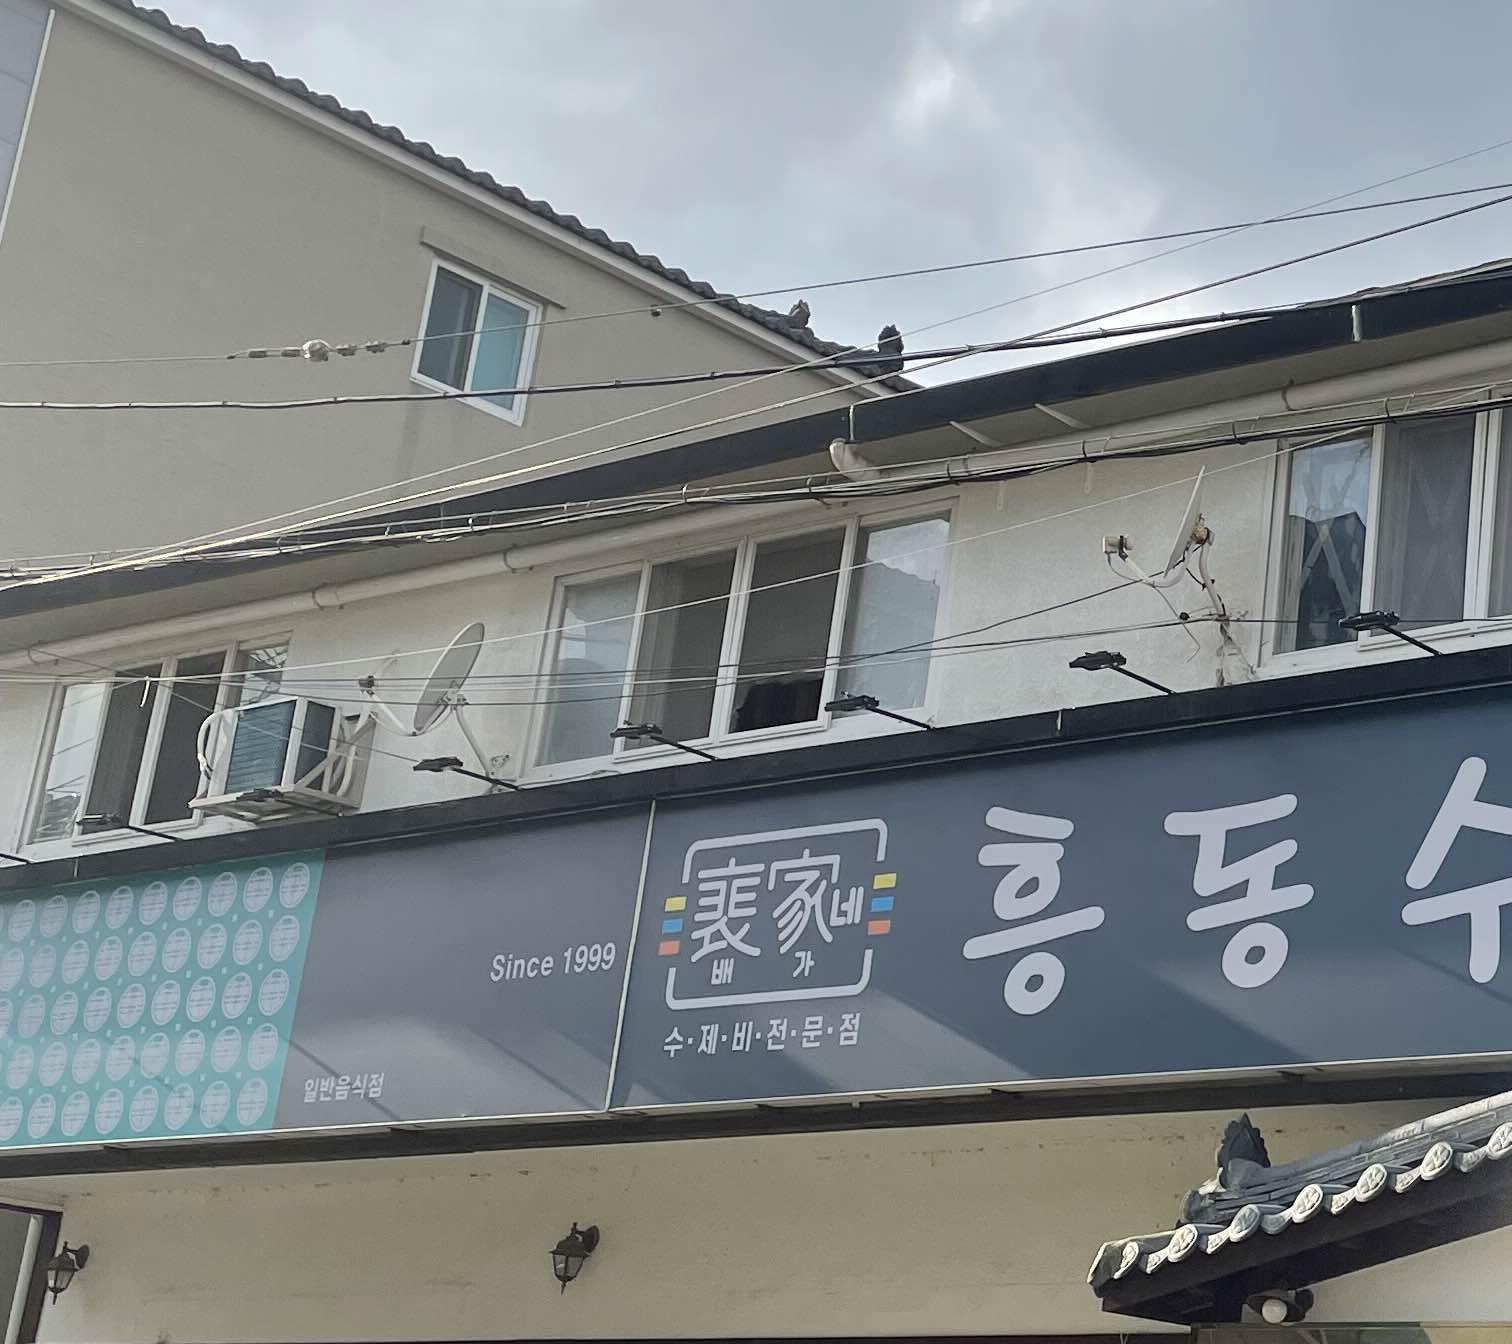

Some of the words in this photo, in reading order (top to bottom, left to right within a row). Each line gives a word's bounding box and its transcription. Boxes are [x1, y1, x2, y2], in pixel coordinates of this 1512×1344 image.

[490, 954, 554, 983] Since
[563, 942, 616, 975] 1999
[711, 958, 734, 985] 배
[792, 951, 815, 978] 가
[304, 1072, 385, 1103] 일반음식점
